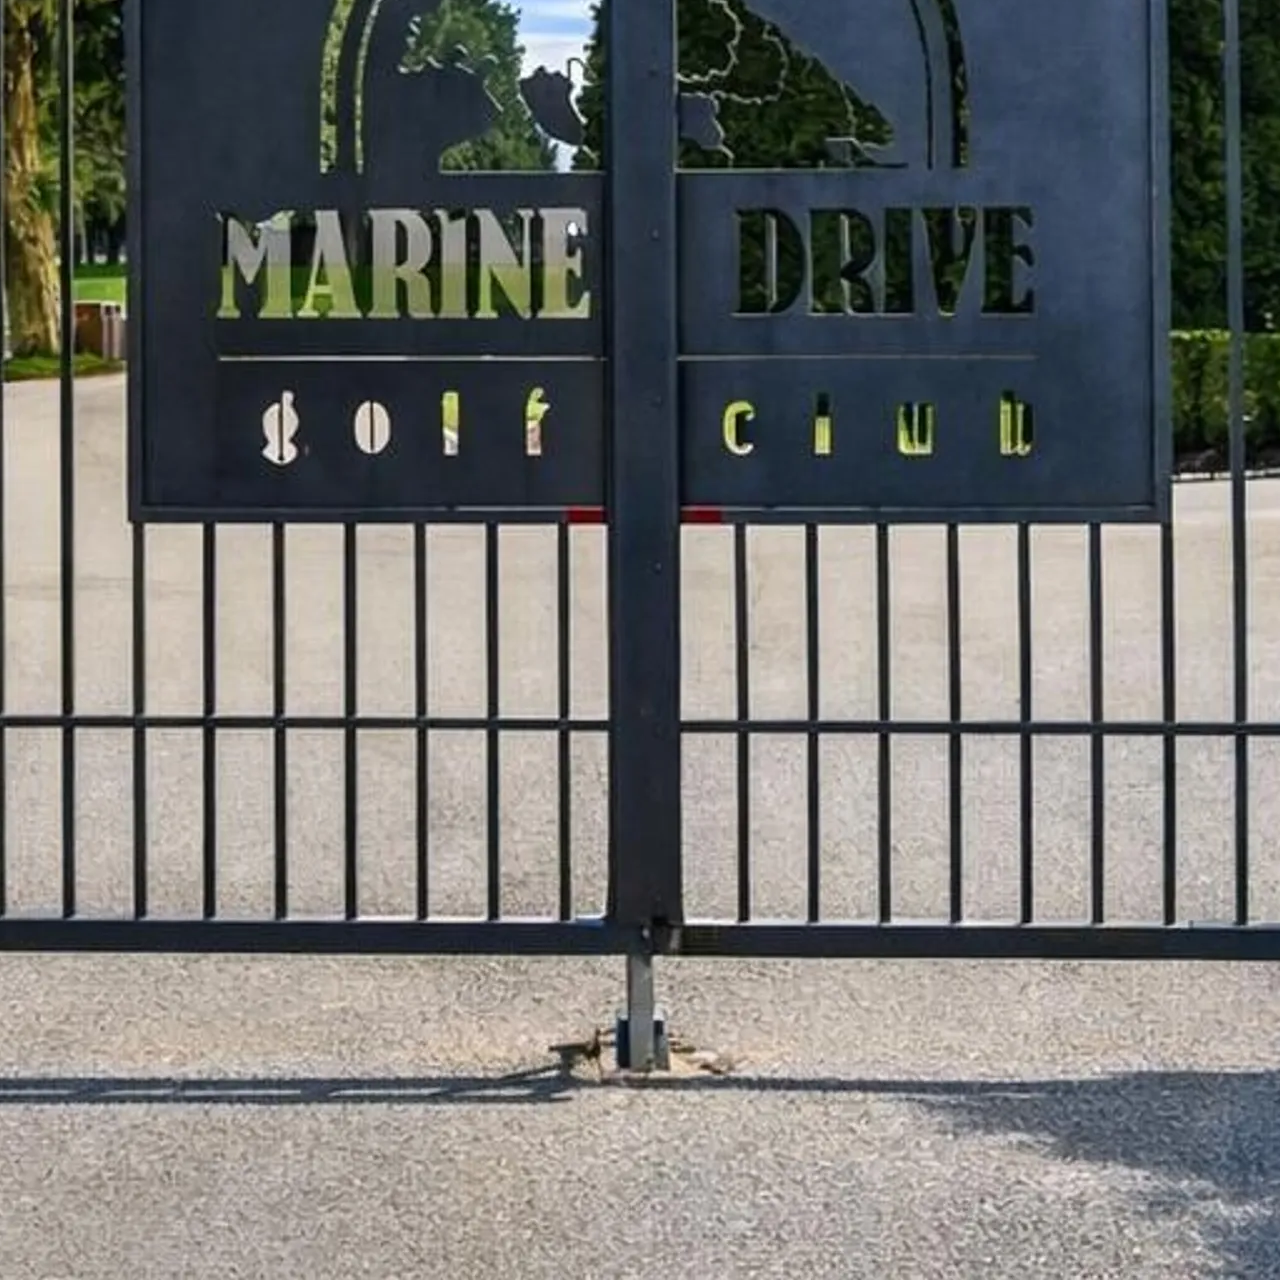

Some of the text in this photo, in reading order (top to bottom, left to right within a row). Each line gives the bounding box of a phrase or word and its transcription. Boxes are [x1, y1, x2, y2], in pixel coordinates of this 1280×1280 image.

[216, 206, 1036, 319] MARINE DRIVE
[261, 387, 1036, 464] golf club
